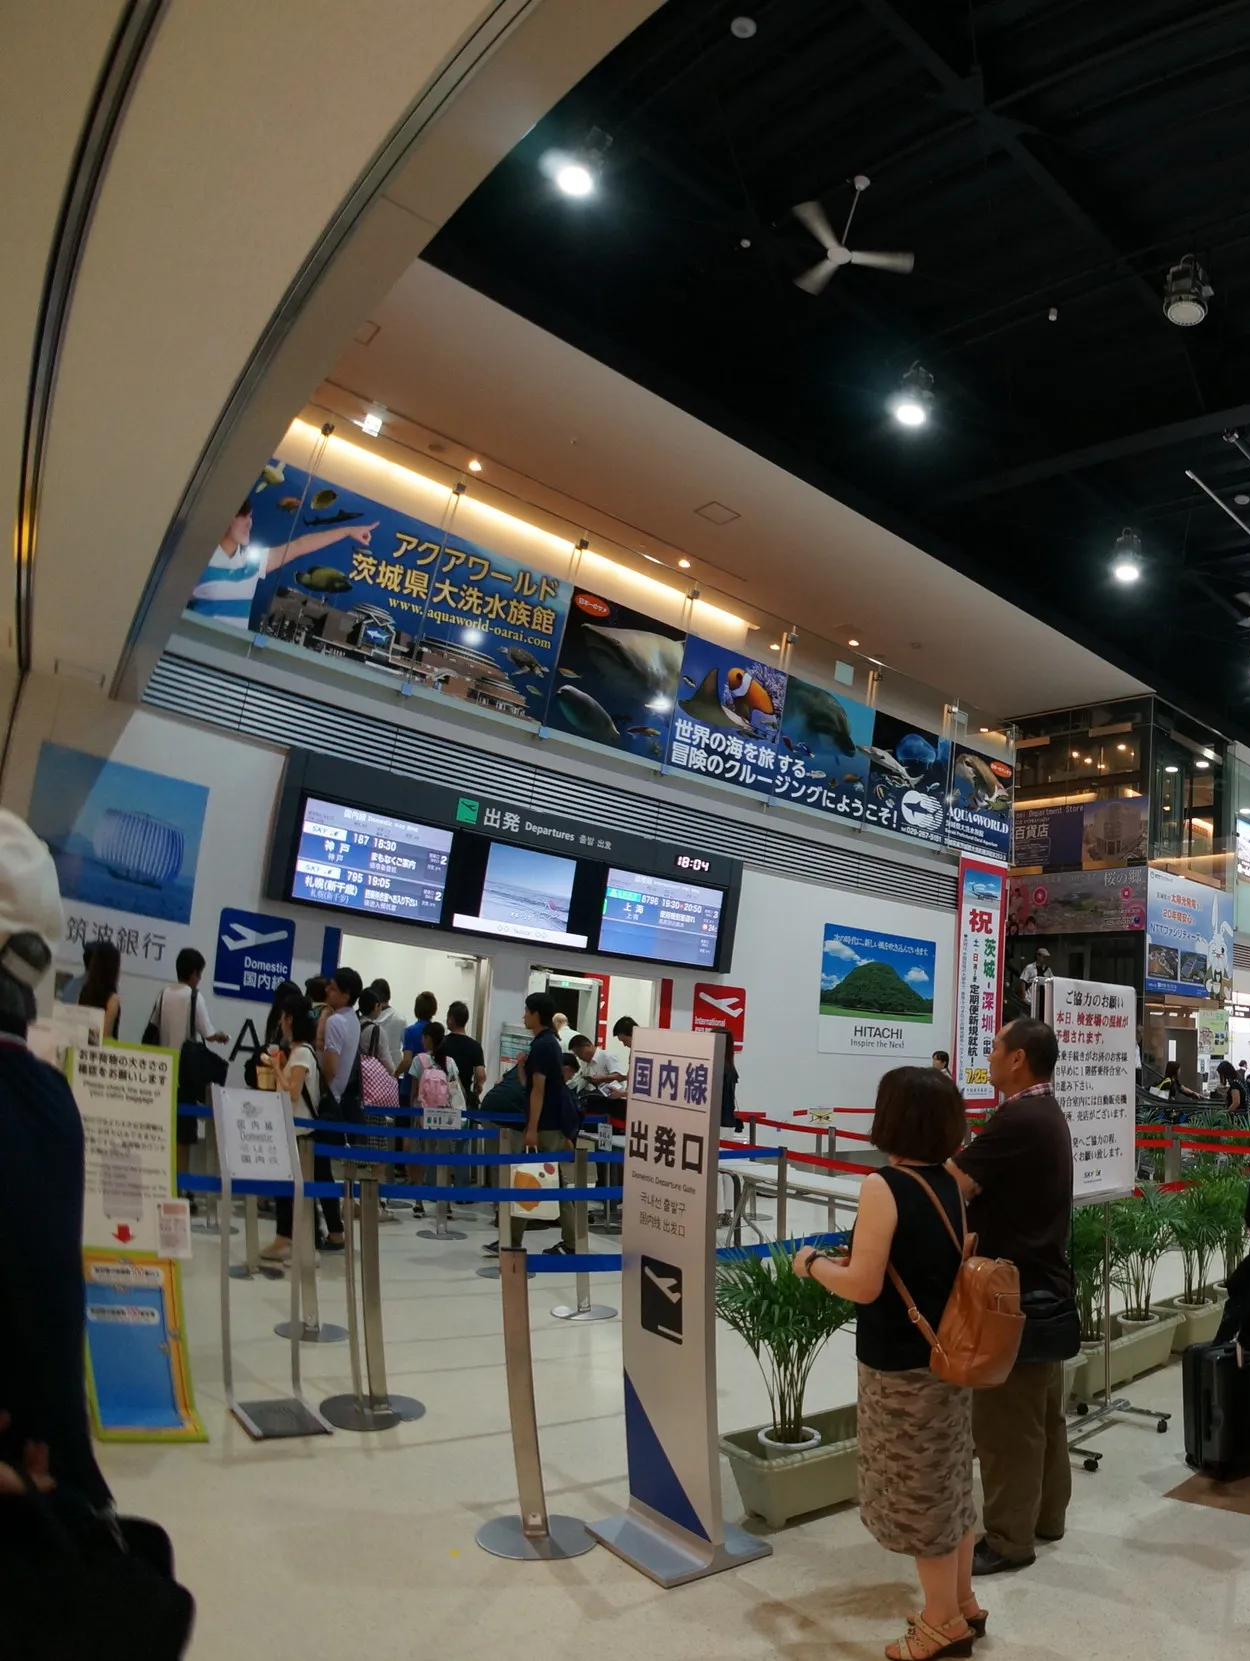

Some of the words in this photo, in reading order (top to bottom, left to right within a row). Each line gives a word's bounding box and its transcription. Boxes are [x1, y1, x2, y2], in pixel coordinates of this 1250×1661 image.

[392, 532, 560, 601] アクアワールド
[388, 598, 551, 649] www.aquaworld-oarai.com
[674, 718, 807, 779] 世界の海を旅する
[1028, 807, 1063, 818] Department
[1065, 806, 1084, 814] Store
[484, 807, 521, 833] 出発
[525, 822, 575, 842] Departures
[1015, 824, 1050, 840] 百貨店
[353, 833, 370, 845] 187
[373, 838, 397, 852] 18:30
[441, 855, 448, 866] 2
[676, 856, 710, 872] 18:04
[347, 870, 364, 883] 795
[367, 875, 391, 889] 19:05
[435, 892, 442, 901] 2
[968, 908, 993, 934] 祝
[65, 915, 168, 962] 筑波銀行
[243, 955, 288, 974] Domestic
[1065, 990, 1124, 1009] ご協力のお願い
[853, 1025, 903, 1040] HITACHI
[850, 1038, 875, 1048] Inspire
[876, 1038, 888, 1047] the
[889, 1040, 905, 1049] Next
[633, 1057, 710, 1105] 国内線
[629, 1120, 704, 1175] 出発口
[631, 1170, 655, 1185] Domestic
[655, 1176, 682, 1192] Departure
[682, 1183, 697, 1195] Gate
[639, 1191, 662, 1210] 국내선
